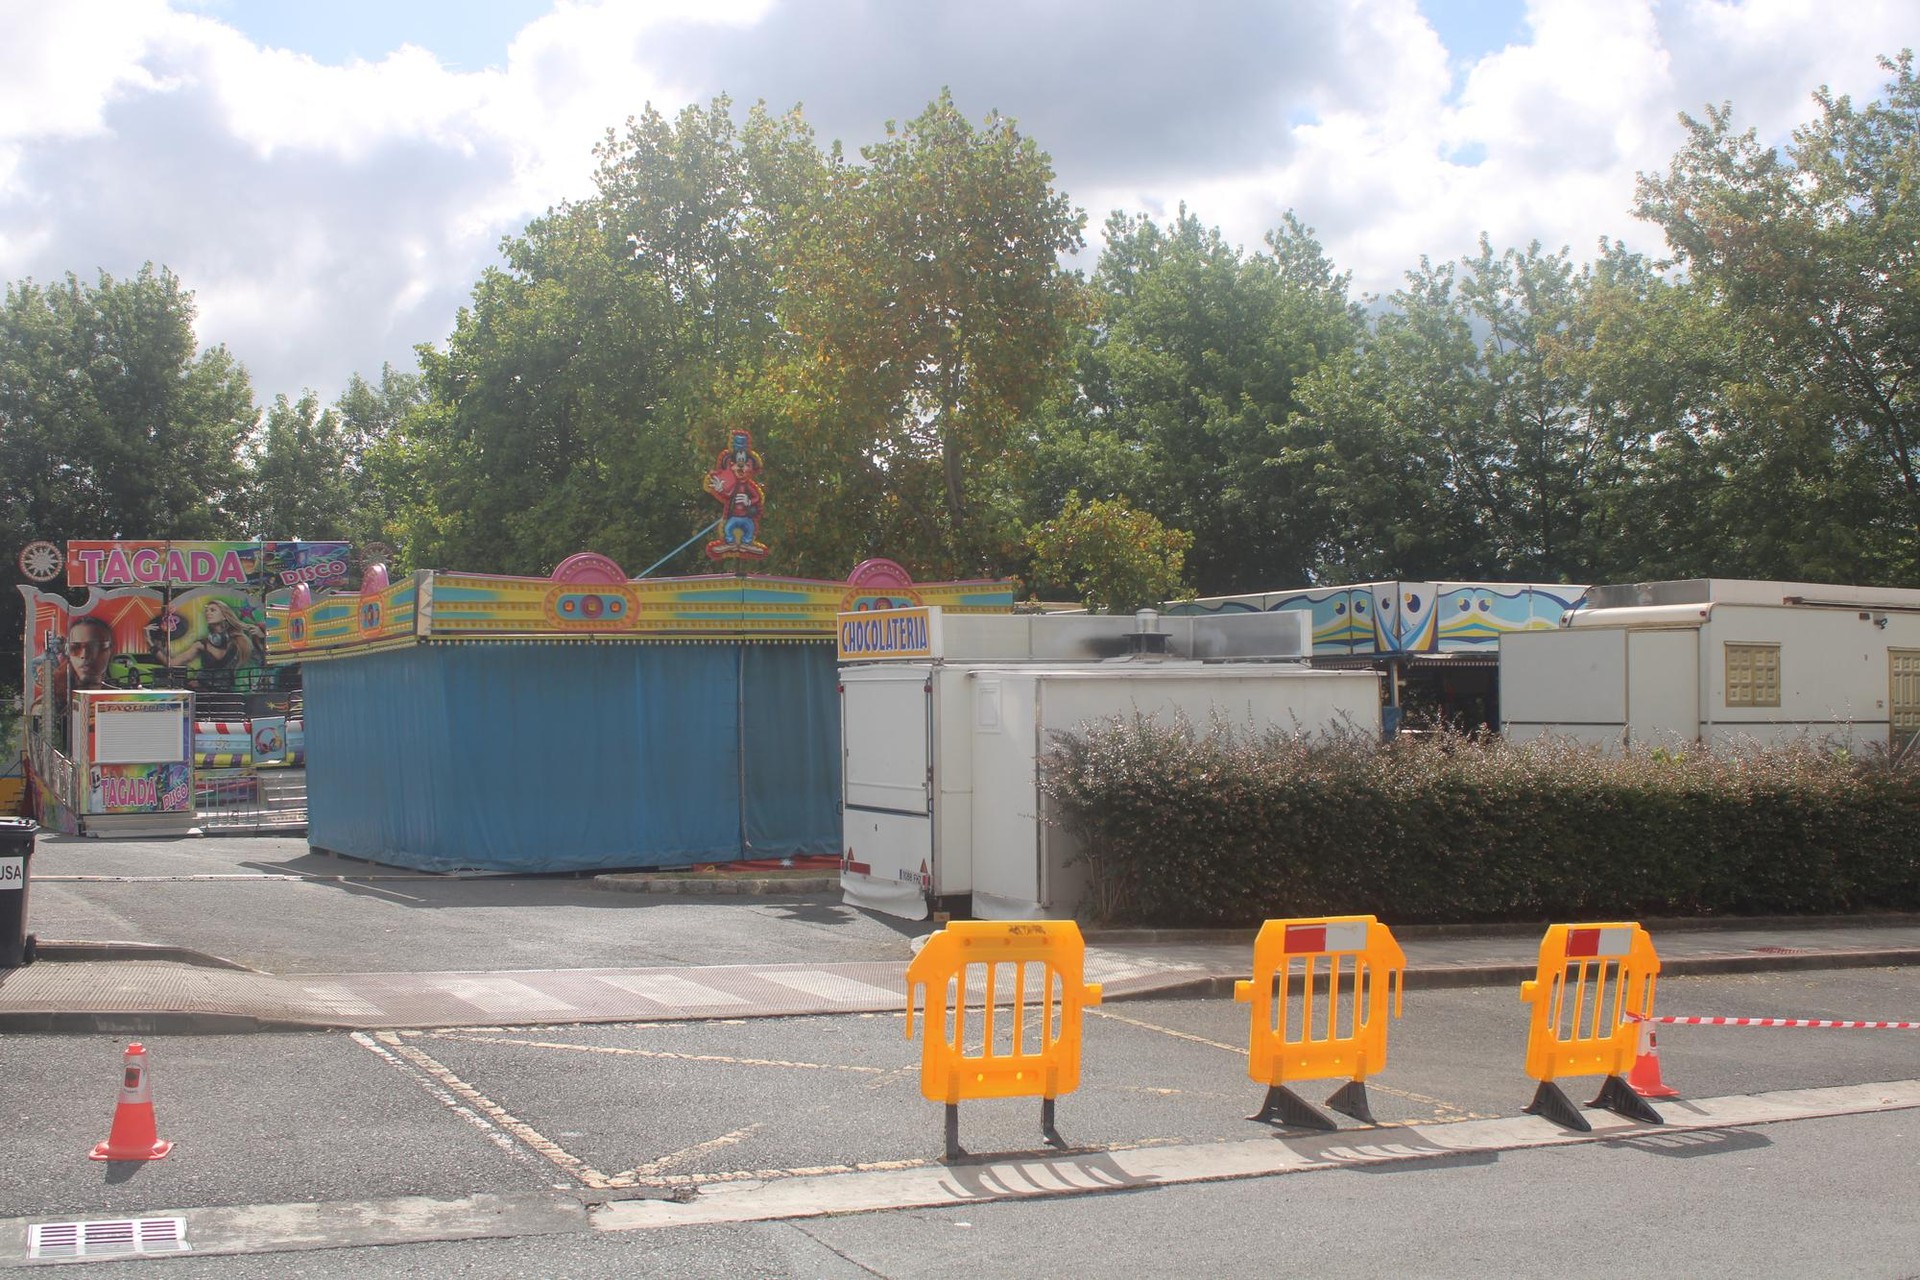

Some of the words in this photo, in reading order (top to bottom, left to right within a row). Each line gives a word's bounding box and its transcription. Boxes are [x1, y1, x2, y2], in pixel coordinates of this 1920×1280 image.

[79, 550, 248, 585] TAGADA
[280, 560, 347, 585] DISCO
[842, 615, 928, 653] CHOCOLATERIA
[101, 777, 158, 807] TAGADA
[162, 782, 188, 811] DISCO
